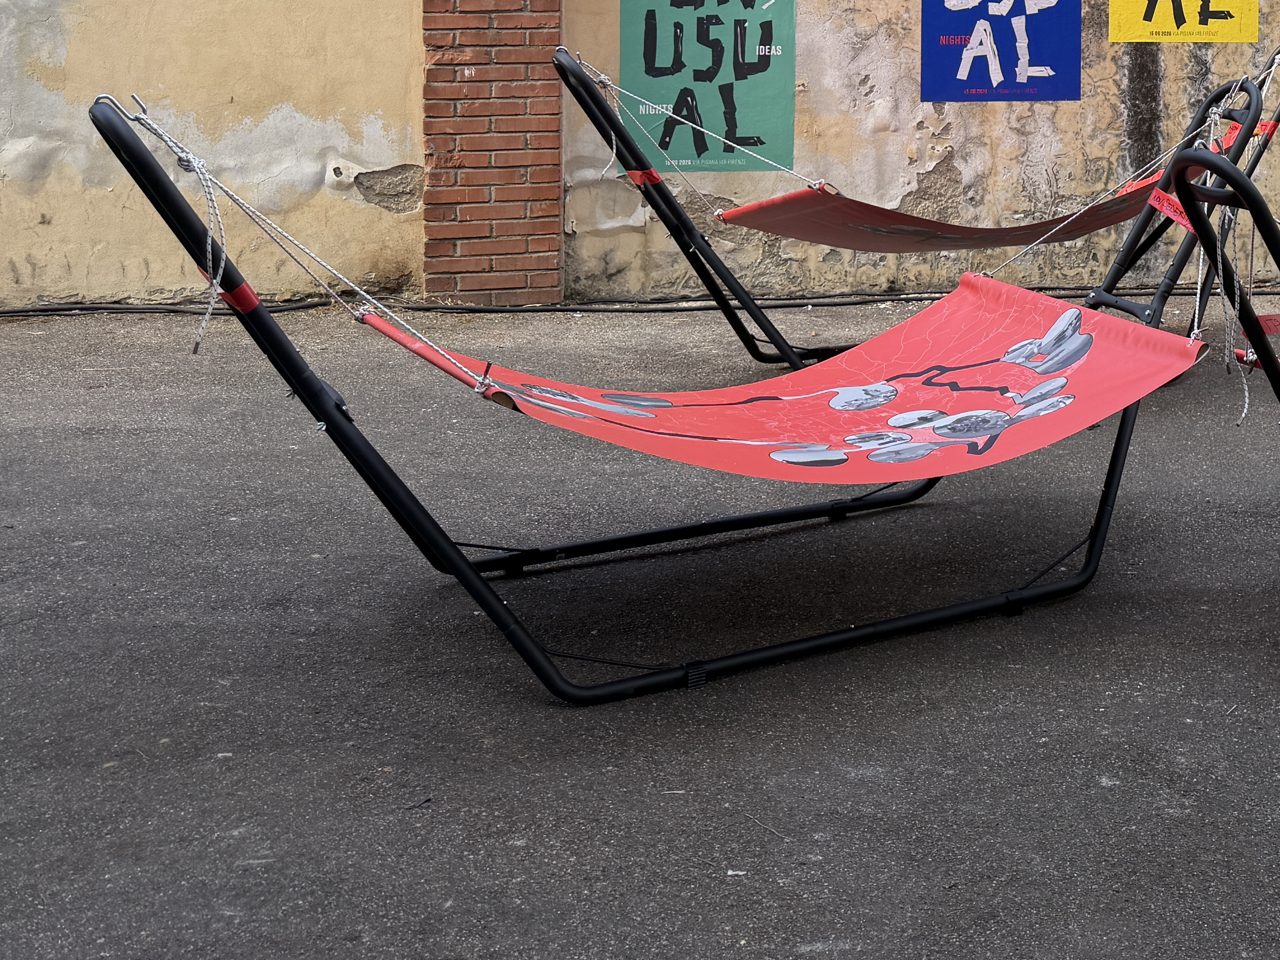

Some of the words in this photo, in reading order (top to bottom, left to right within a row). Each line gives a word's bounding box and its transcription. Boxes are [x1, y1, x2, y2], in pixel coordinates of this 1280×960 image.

[643, 9, 773, 83] USU
[756, 45, 782, 56] IDEAS
[940, 35, 971, 45] NIGHTS
[956, 15, 1056, 88] AL
[639, 104, 674, 115] NIGHTS
[658, 82, 767, 159] AL
